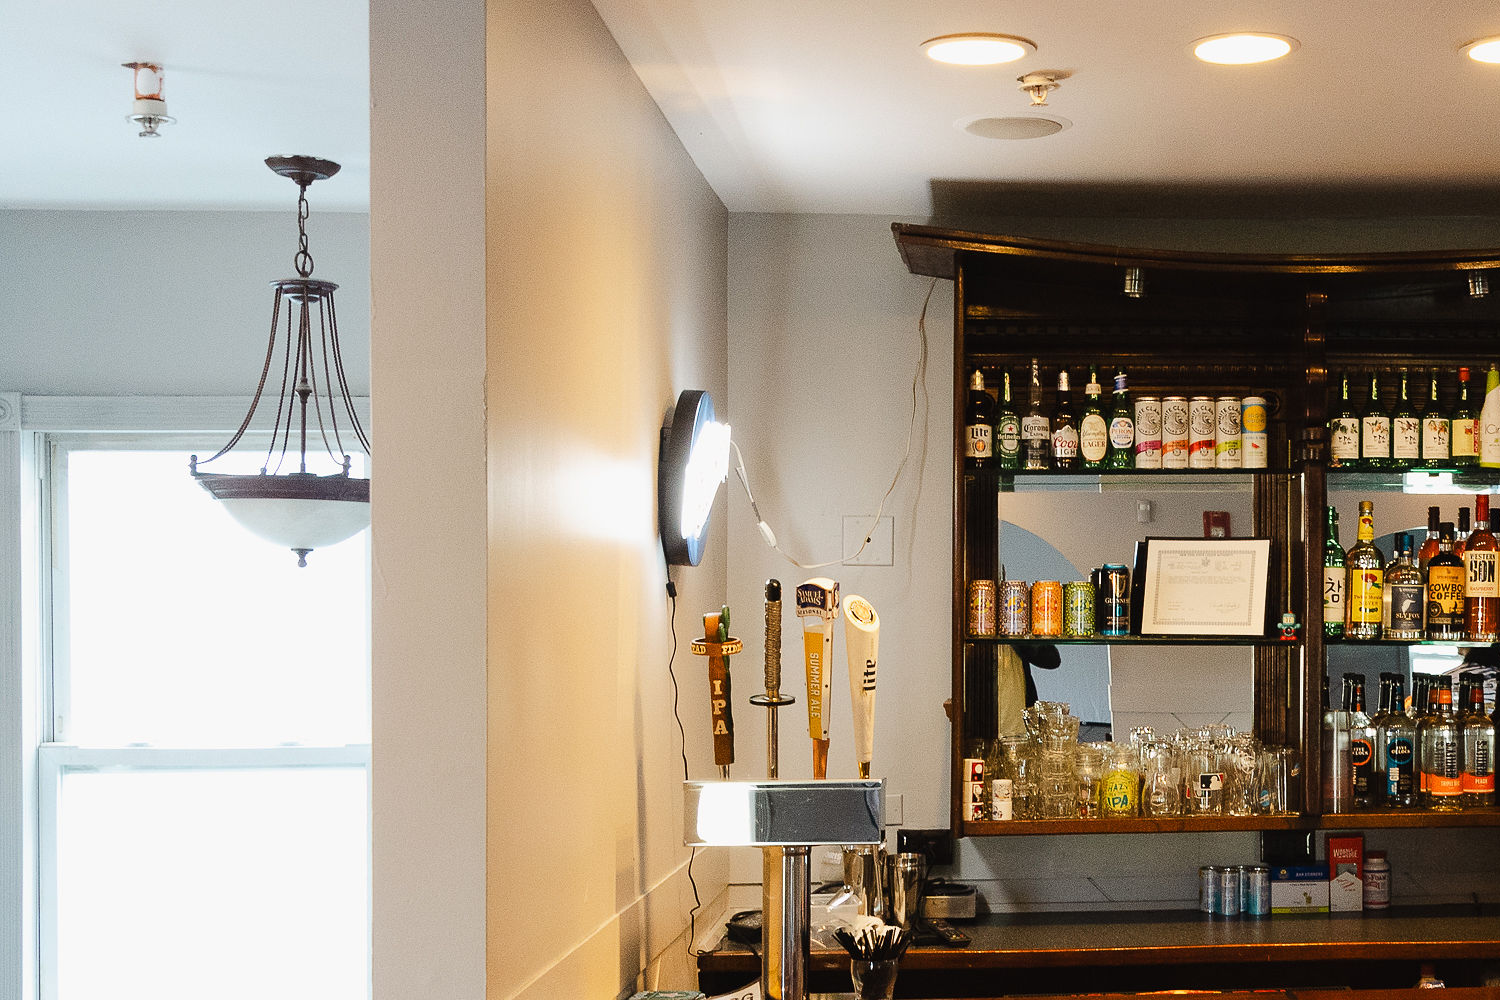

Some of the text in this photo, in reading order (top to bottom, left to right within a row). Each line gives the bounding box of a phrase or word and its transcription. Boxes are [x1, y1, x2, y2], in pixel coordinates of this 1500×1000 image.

[971, 427, 989, 439] Lite
[1024, 424, 1049, 433] Corona
[1469, 560, 1496, 583] SON
[1325, 577, 1342, 603] 참
[809, 652, 821, 719] SUMMER ALE
[712, 679, 728, 735] IPA
[1107, 794, 1129, 808] IPA
